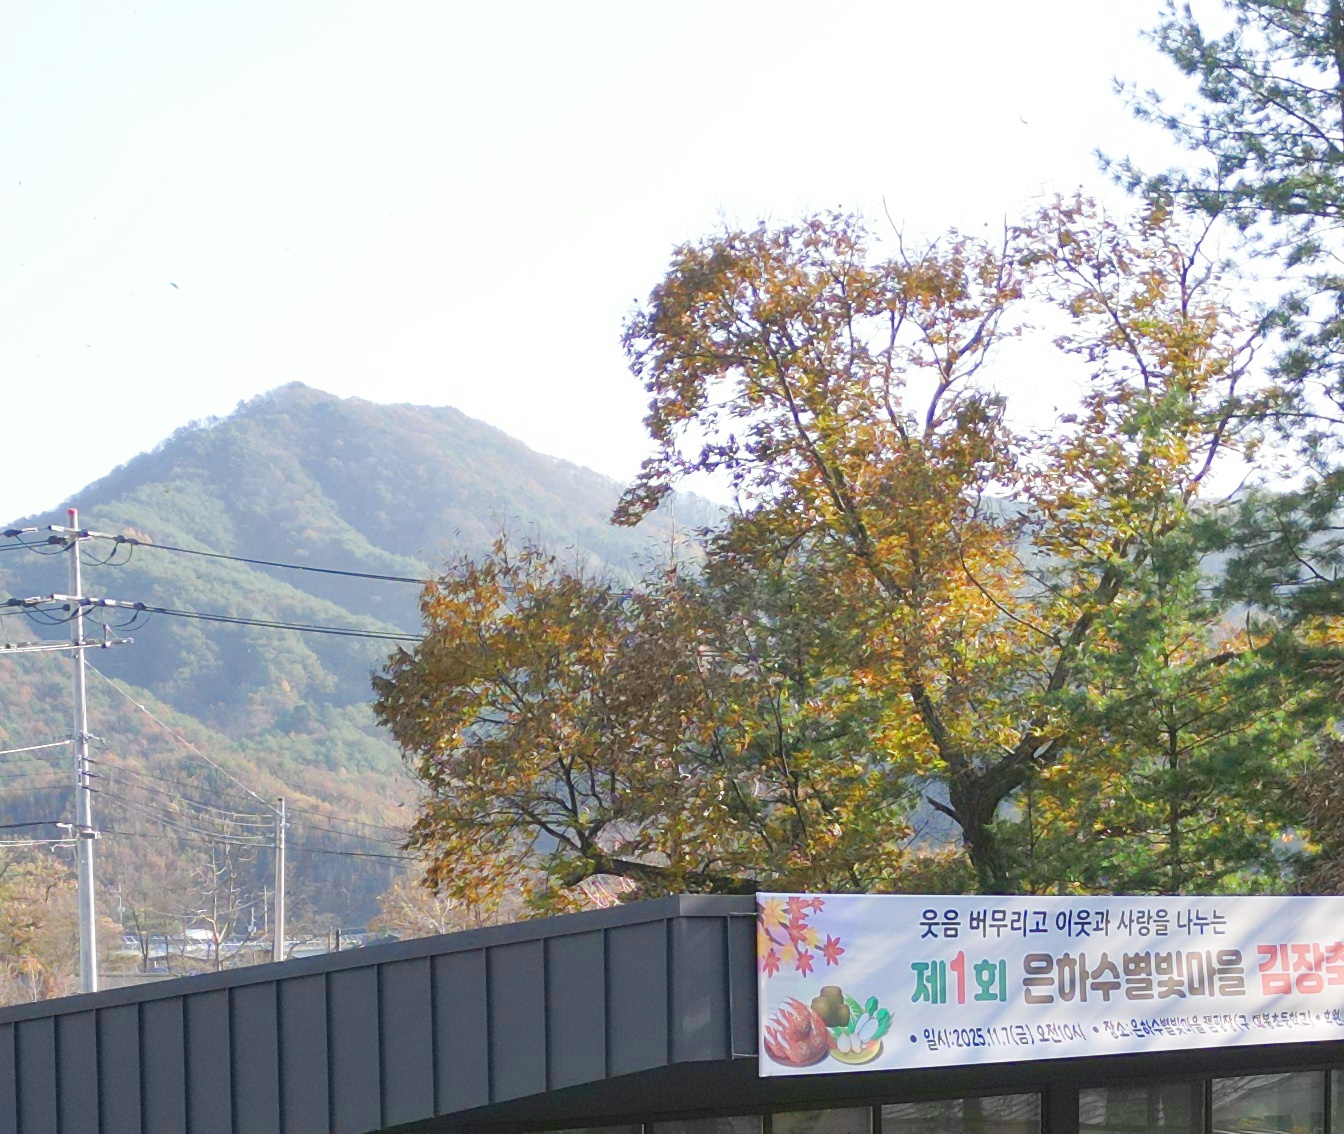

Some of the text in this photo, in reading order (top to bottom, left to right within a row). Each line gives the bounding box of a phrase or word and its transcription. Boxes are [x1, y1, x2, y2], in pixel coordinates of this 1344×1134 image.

[919, 908, 1227, 939] 웃음 버무리고 이웃과 사랑을 나누는
[910, 950, 1007, 1005] 제1회
[1022, 949, 1246, 1005] 은하수별빛마을
[1036, 1022, 1087, 1044] 오전10시
